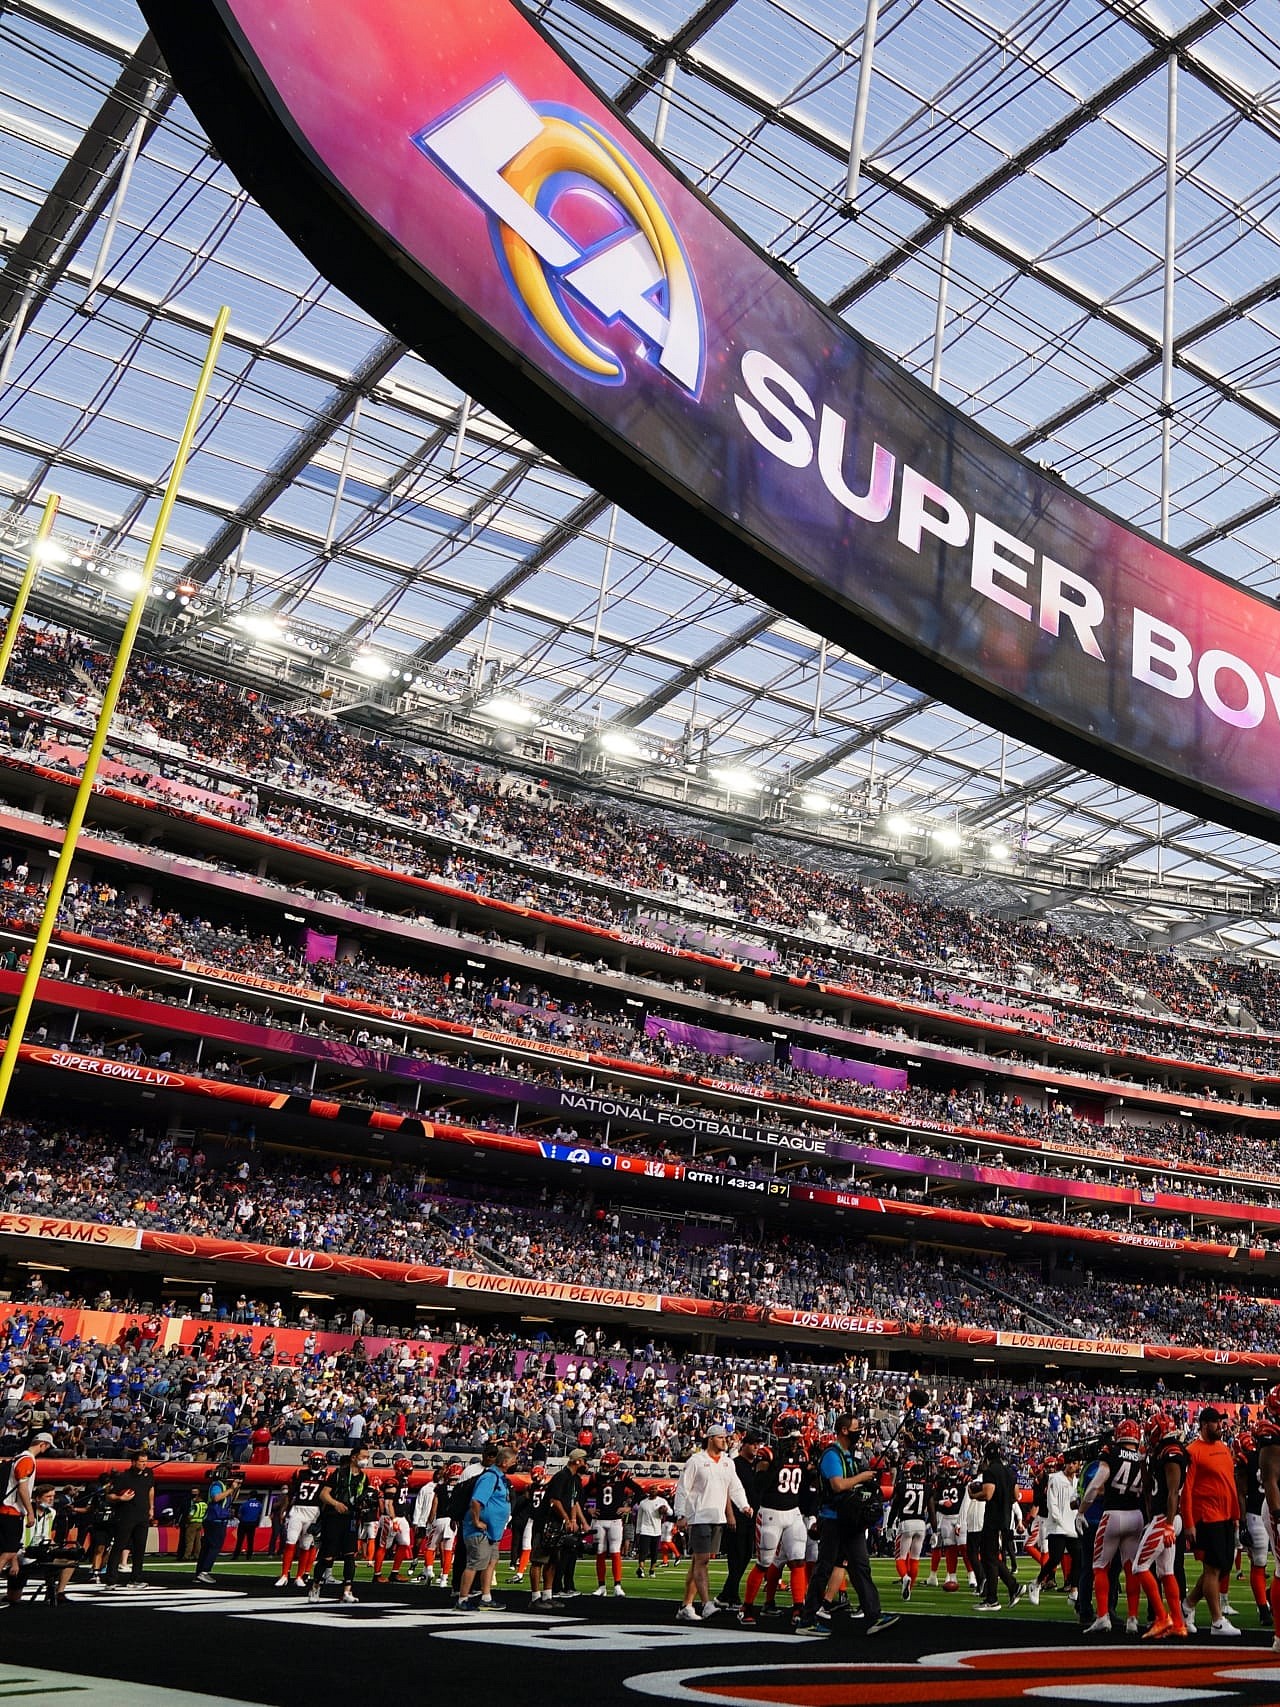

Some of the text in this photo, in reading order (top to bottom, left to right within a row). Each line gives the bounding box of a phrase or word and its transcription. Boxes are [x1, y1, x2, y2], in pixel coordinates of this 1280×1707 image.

[734, 349, 1106, 662] SUPER
[196, 965, 309, 999] LOS ANGELES RAMS
[482, 1031, 580, 1059] CINCINNATI BENGALS
[50, 1053, 170, 1086] SUPER BOWL LVI
[711, 1079, 765, 1098] LOS ANGELES
[560, 1093, 826, 1153] NATIONAL FOOTBALL LEAGUE
[687, 1171, 713, 1184] QTR
[714, 1174, 720, 1184] 1
[727, 1178, 765, 1191] 43:34
[770, 1184, 787, 1195] 37
[38, 1219, 110, 1244] RAMS
[1118, 1234, 1177, 1249] SUPER BOWL LVI
[286, 1250, 315, 1269] LVI
[466, 1274, 646, 1308] CINCINNATI BENGALS
[792, 1313, 884, 1333] LOS ANGELES
[1011, 1335, 1129, 1355] LOS ANGELES RAMS
[1214, 1351, 1229, 1363] LVI
[299, 1482, 320, 1501] 57
[777, 1467, 803, 1494] 90
[603, 1486, 613, 1506] 8
[902, 1490, 924, 1515] 21
